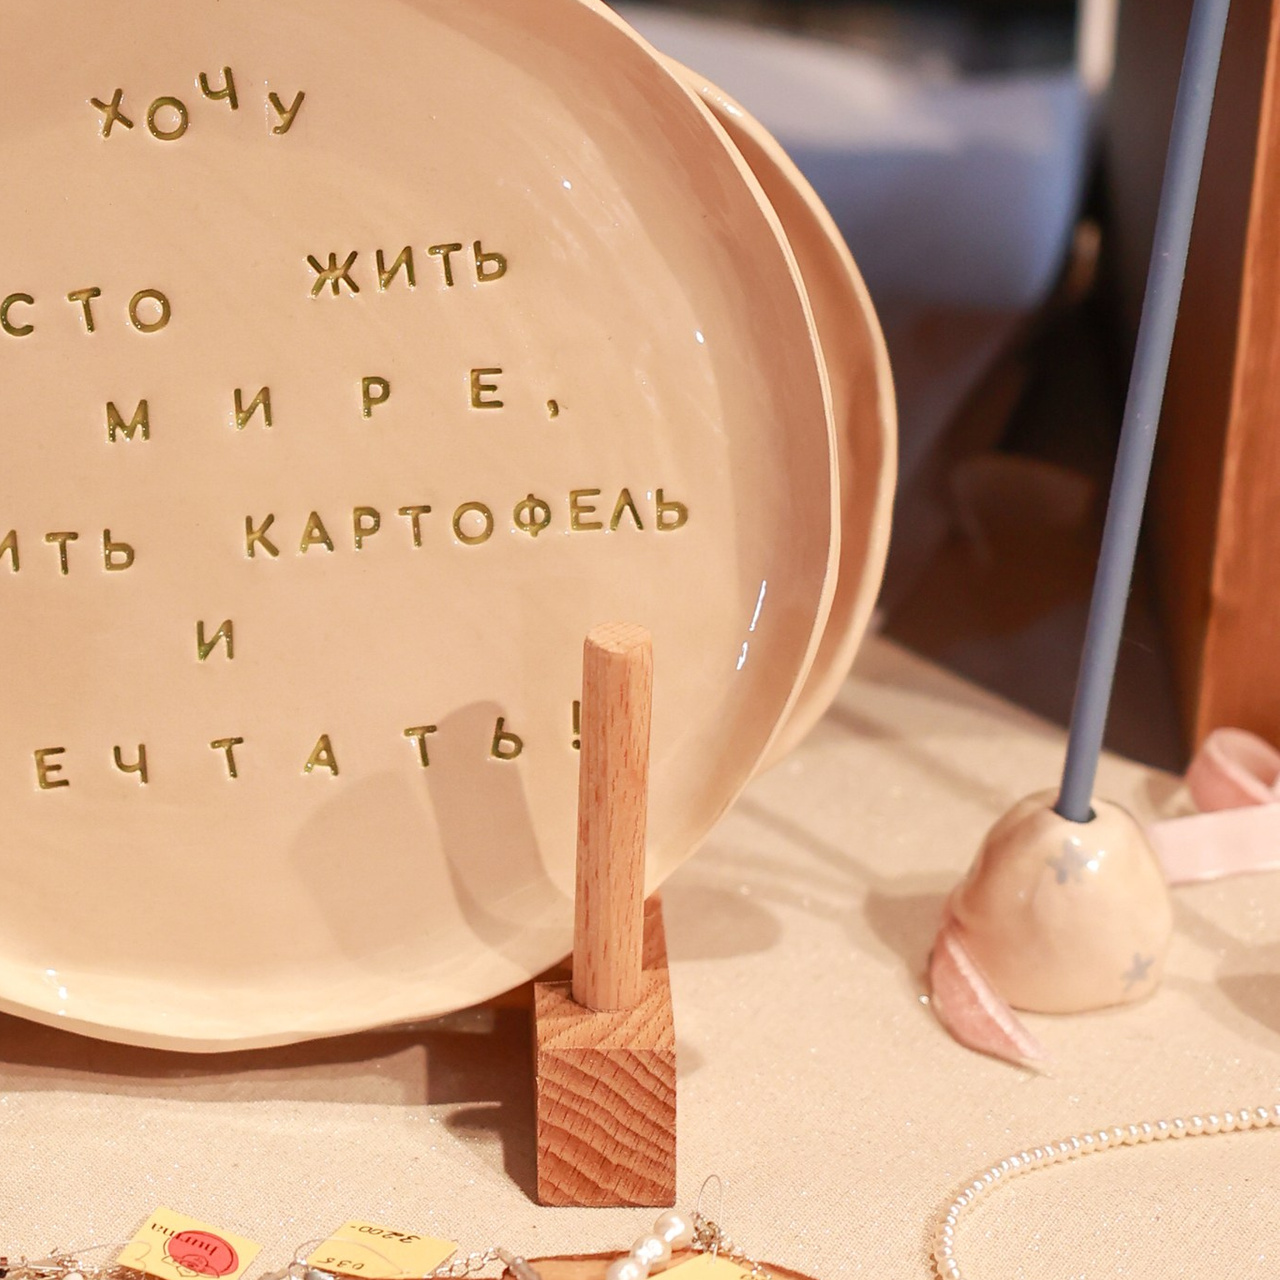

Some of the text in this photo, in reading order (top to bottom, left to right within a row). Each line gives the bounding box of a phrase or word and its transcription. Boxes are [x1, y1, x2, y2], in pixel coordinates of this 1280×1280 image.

[90, 66, 306, 141] ХОЧУ
[306, 239, 508, 297] ЖИТЬ
[242, 487, 690, 560] КАРТОФЕЛЬ
[196, 619, 235, 661] И
